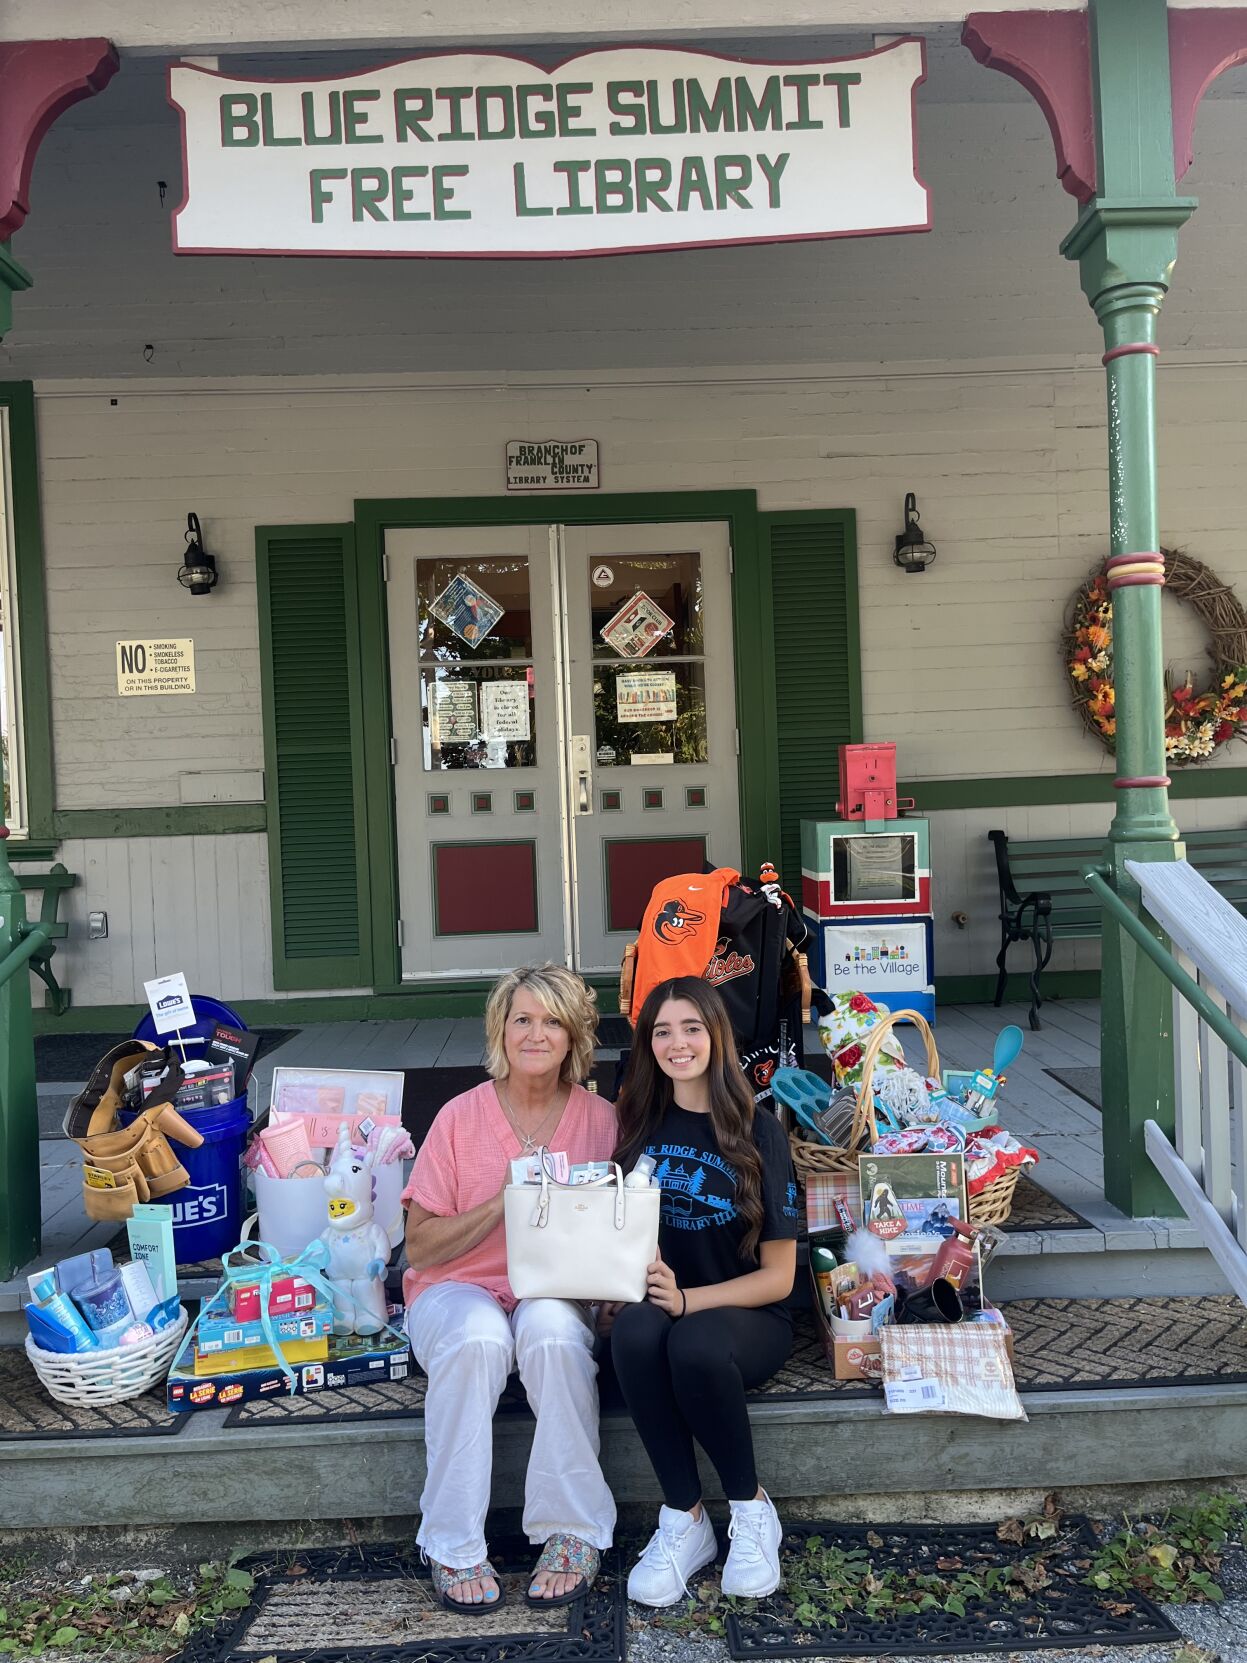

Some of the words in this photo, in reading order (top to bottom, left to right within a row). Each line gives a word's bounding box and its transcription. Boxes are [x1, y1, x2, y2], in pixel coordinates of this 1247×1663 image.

[219, 89, 384, 148] BLUE
[393, 82, 596, 143] RIDGE
[606, 72, 862, 136] SUMMIT
[309, 164, 472, 224] FREE
[513, 152, 790, 217] LIBRARY
[508, 454, 565, 466] FRANKLIN
[551, 464, 593, 475] COUNTY
[508, 476, 547, 484] LIBRARY
[554, 476, 590, 484] SYSTEM
[121, 644, 146, 674] NO
[834, 964, 850, 975] Be
[854, 963, 877, 975] the
[880, 962, 920, 975] Village
[660, 1144, 698, 1157] RIDGE
[902, 1203, 924, 1211] TIME
[666, 1216, 711, 1230] LIBRARY
[132, 1244, 158, 1252] COMFORT
